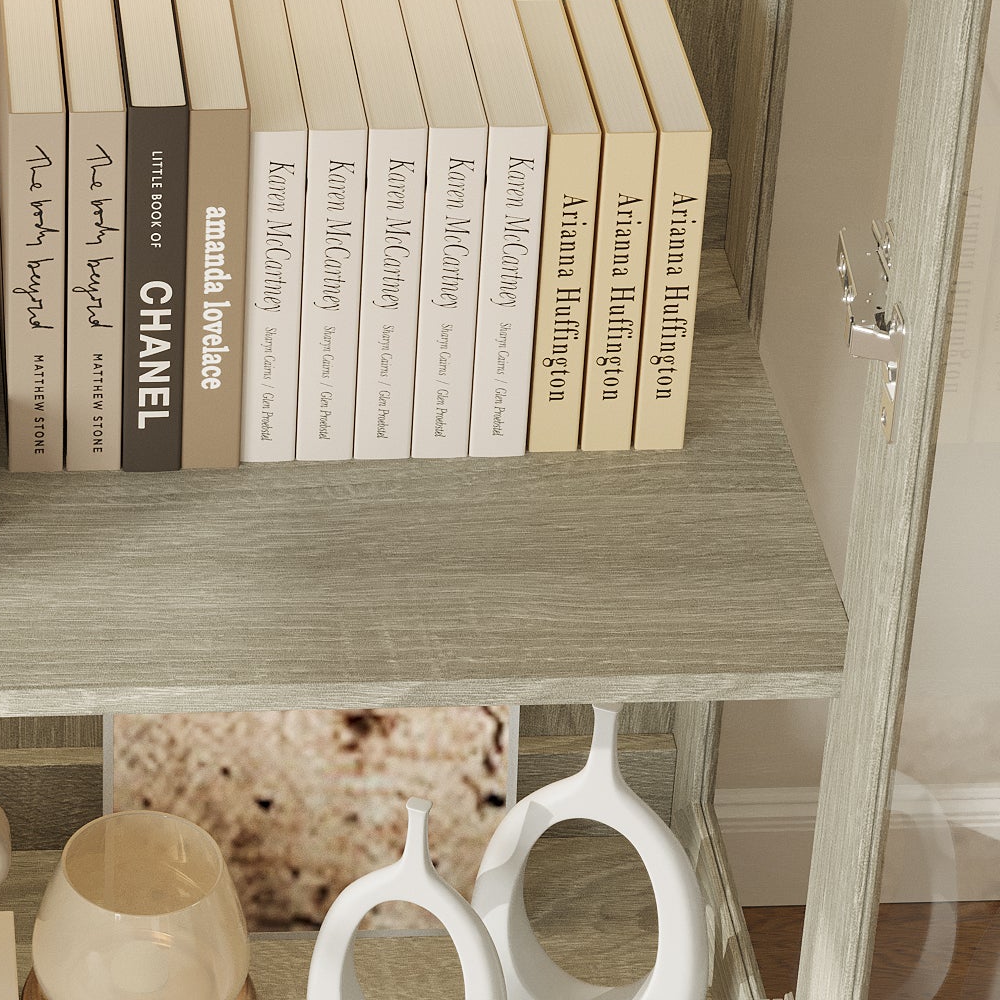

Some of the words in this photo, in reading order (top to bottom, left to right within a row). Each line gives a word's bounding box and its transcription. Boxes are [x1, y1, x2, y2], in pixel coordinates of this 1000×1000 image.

[150, 151, 163, 189] LITTLE
[266, 161, 295, 213] Karen
[326, 159, 355, 212] Karen
[385, 158, 415, 211] Karen
[445, 157, 475, 209] Karen
[506, 155, 535, 208] Karen
[150, 194, 163, 228] BOOK
[557, 194, 589, 278] Arianna
[611, 193, 643, 277] Arianna
[666, 191, 698, 276] Arianna
[150, 233, 162, 248] OF
[203, 206, 232, 295] amanda
[254, 219, 292, 313] McCartney
[314, 218, 352, 311] McCartney
[372, 217, 412, 310] McCartney
[431, 215, 471, 309] McCartney
[490, 214, 531, 308] McCartney
[138, 280, 173, 430] CHANEL
[200, 301, 231, 390] lovelace
[262, 355, 275, 380] Cairns
[321, 354, 334, 379] Cairns
[379, 353, 393, 377] Cairns
[437, 351, 452, 376] Cairns
[496, 350, 510, 375] Cairns
[542, 287, 581, 402] Huffington
[596, 286, 636, 401] Huffington
[649, 285, 690, 400] Huffington
[33, 355, 45, 412] MATTHEW
[92, 353, 103, 410] MATTHEW
[261, 392, 275, 409] Glen
[319, 391, 333, 408] Glen
[377, 390, 390, 407] Glen
[435, 388, 449, 406] Glen
[493, 387, 507, 404] Glen
[33, 417, 45, 455] STONE
[92, 416, 103, 454] STONE
